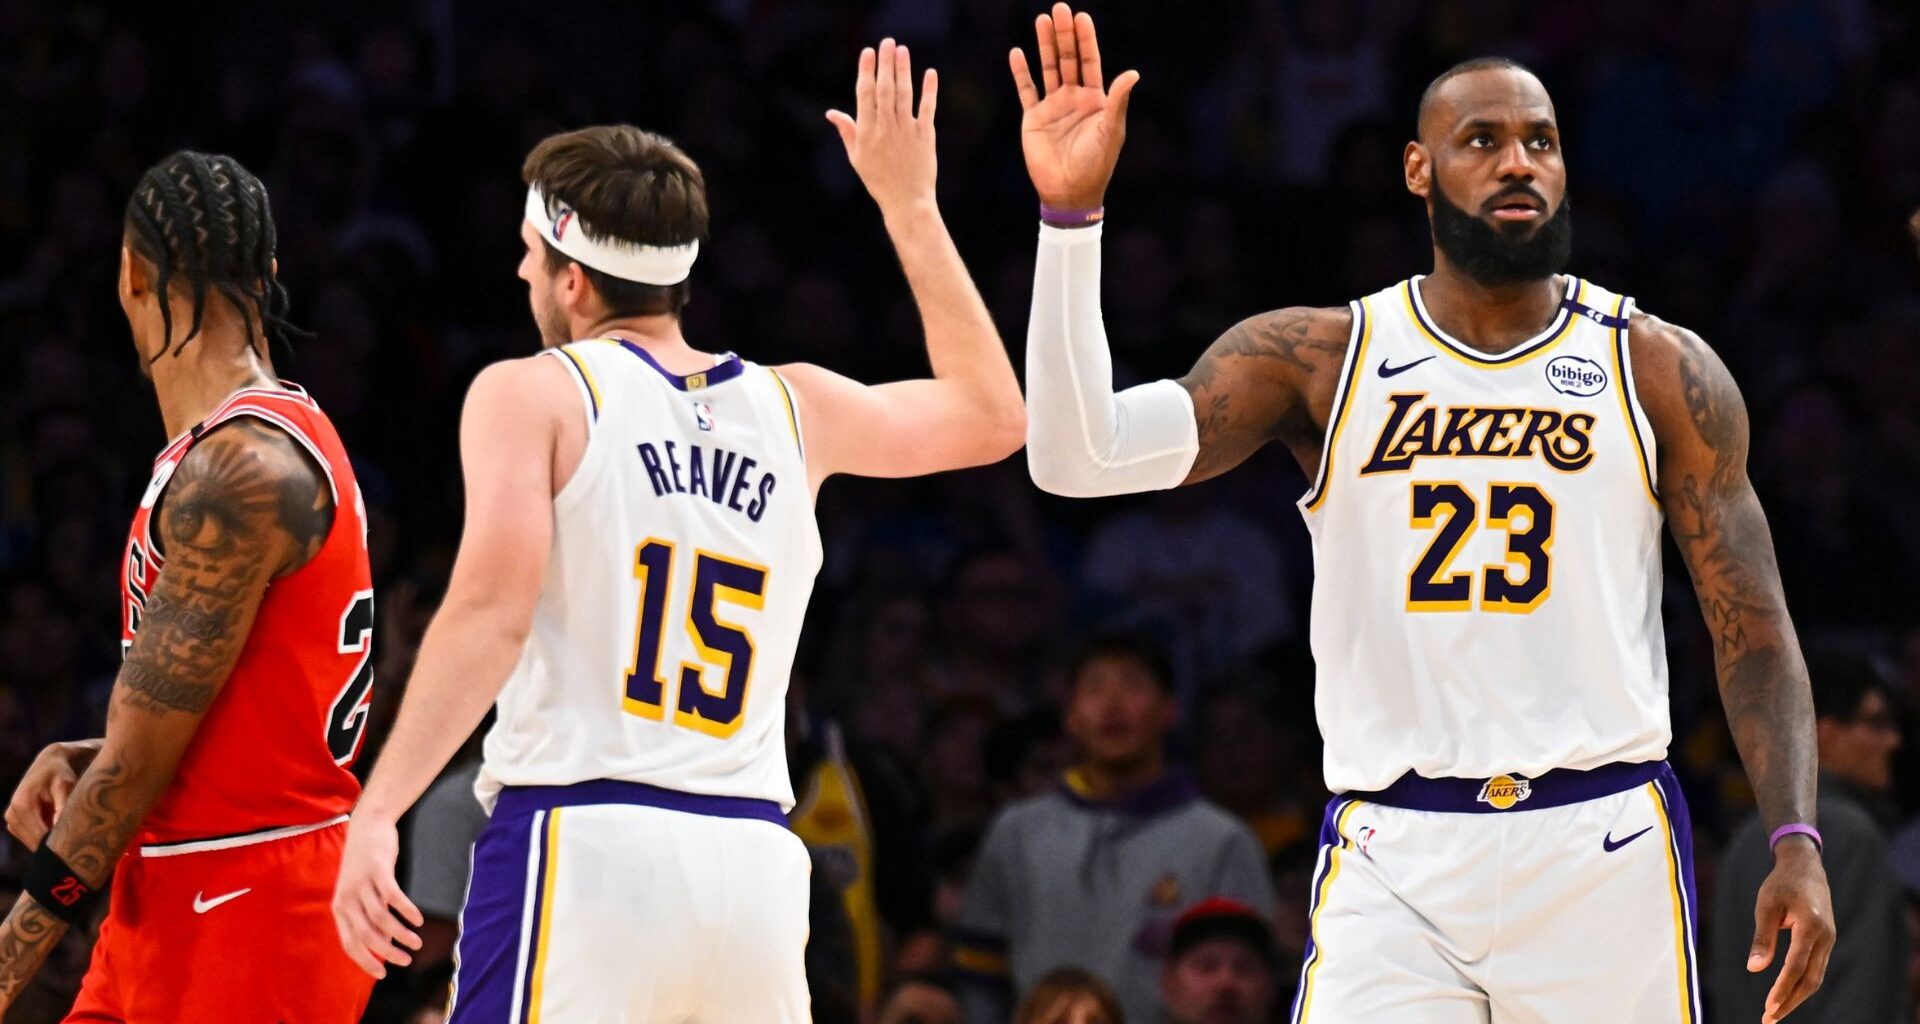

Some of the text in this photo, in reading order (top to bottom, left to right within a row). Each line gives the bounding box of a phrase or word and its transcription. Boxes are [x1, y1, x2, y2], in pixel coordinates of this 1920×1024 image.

[1552, 365, 1603, 387] bibigo
[1358, 392, 1596, 478] LAKERS
[636, 440, 776, 523] REAVES
[1405, 480, 1556, 615] 23
[621, 536, 770, 740] 15
[1479, 783, 1530, 800] LAKERS
[50, 876, 88, 907] 25
